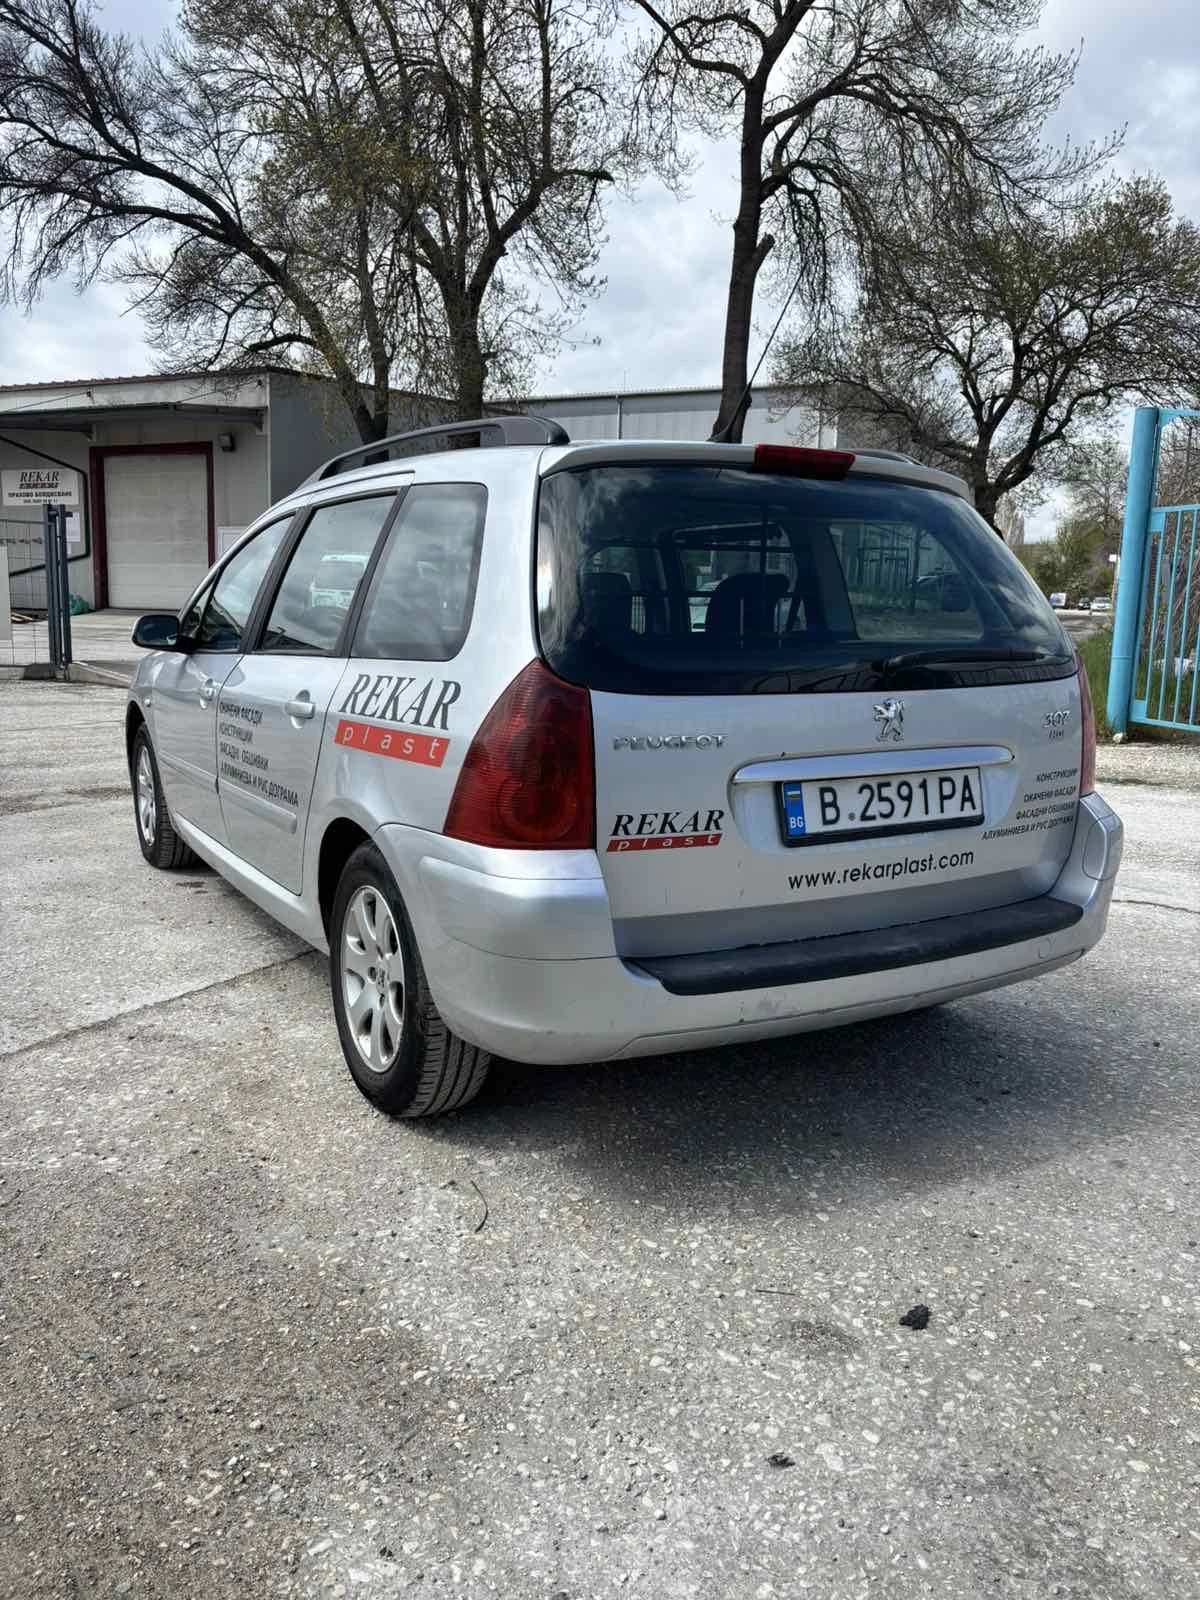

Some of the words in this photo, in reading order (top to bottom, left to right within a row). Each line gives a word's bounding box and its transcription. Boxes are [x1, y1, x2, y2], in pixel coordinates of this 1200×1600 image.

[20, 471, 60, 482] REKAR
[338, 673, 461, 730] REKAR
[241, 707, 263, 726] ФАСАДИ
[1043, 710, 1070, 728] 307
[342, 726, 440, 760] plast
[613, 734, 727, 751] PEUGEOT
[1023, 789, 1054, 803] ОКАЧЕНИ
[1054, 786, 1077, 799] ФАСАДИ
[1016, 806, 1049, 820] ФАСАДНИ
[609, 809, 725, 837] REKAR
[789, 816, 804, 829] BG
[982, 824, 1030, 841] АЛУМИНИЕВА
[616, 834, 716, 852] plast
[788, 850, 975, 890] www.rekarplast.com
